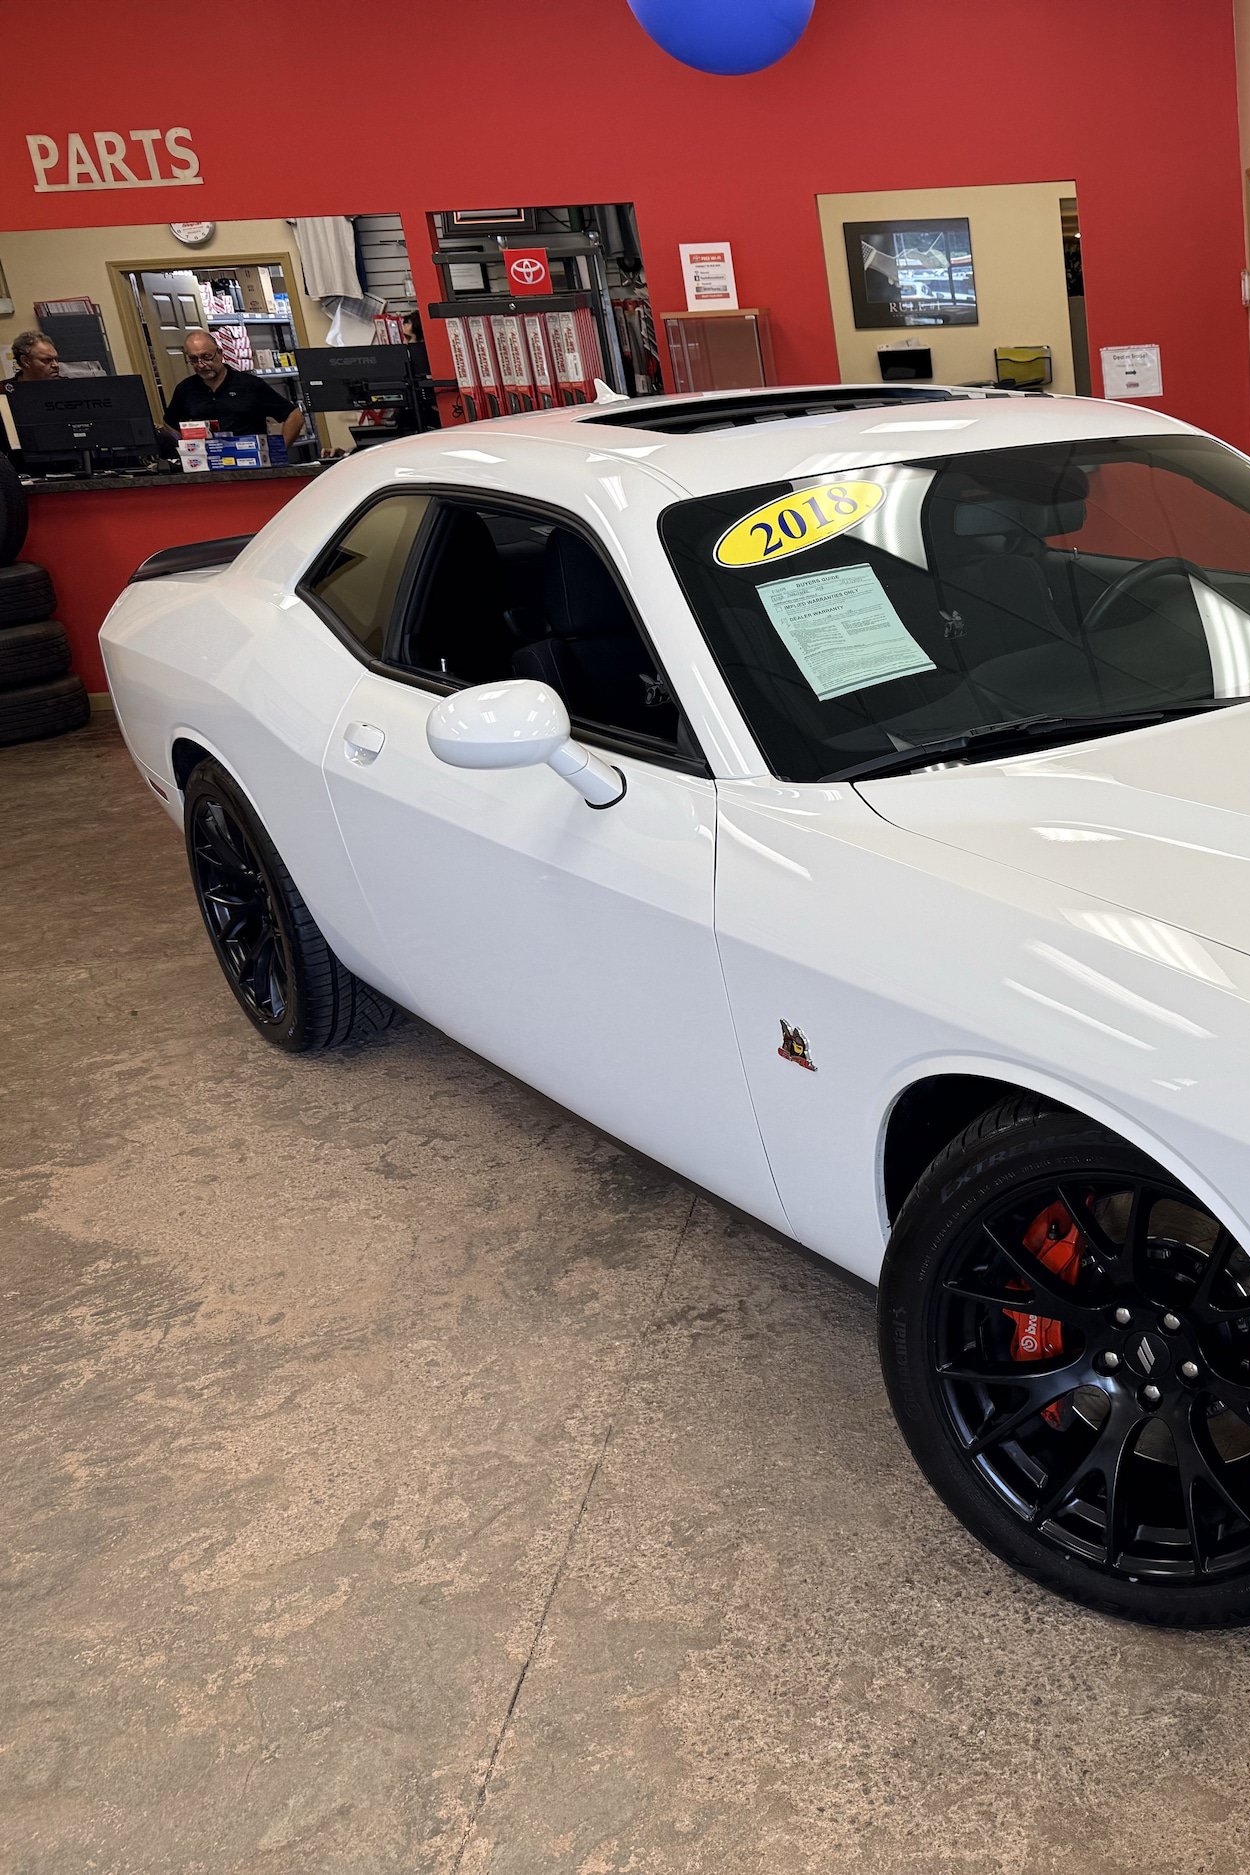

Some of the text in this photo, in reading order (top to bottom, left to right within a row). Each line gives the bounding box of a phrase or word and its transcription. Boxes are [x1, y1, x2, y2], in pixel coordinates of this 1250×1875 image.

[26, 127, 201, 188] PARTS
[889, 300, 926, 313] RULE
[329, 356, 377, 366] SCEPTRE
[453, 332, 466, 378] ALL-WEATHER
[476, 332, 490, 377] ALL-WEATHER
[498, 330, 512, 376] ALL-WEATHER
[510, 331, 523, 376] ALL-WEATHER
[532, 331, 545, 376] ALL-WEATHER
[554, 328, 565, 373] ALL-WEATHER
[44, 399, 112, 411] SCEPTRE
[750, 487, 858, 556] 2018
[784, 601, 807, 610] IMPLIED
[807, 592, 843, 605] WARRANTIES
[843, 588, 860, 596] ONLY
[795, 578, 821, 588] BUYERS
[789, 605, 844, 622] DEALER WARRANTY
